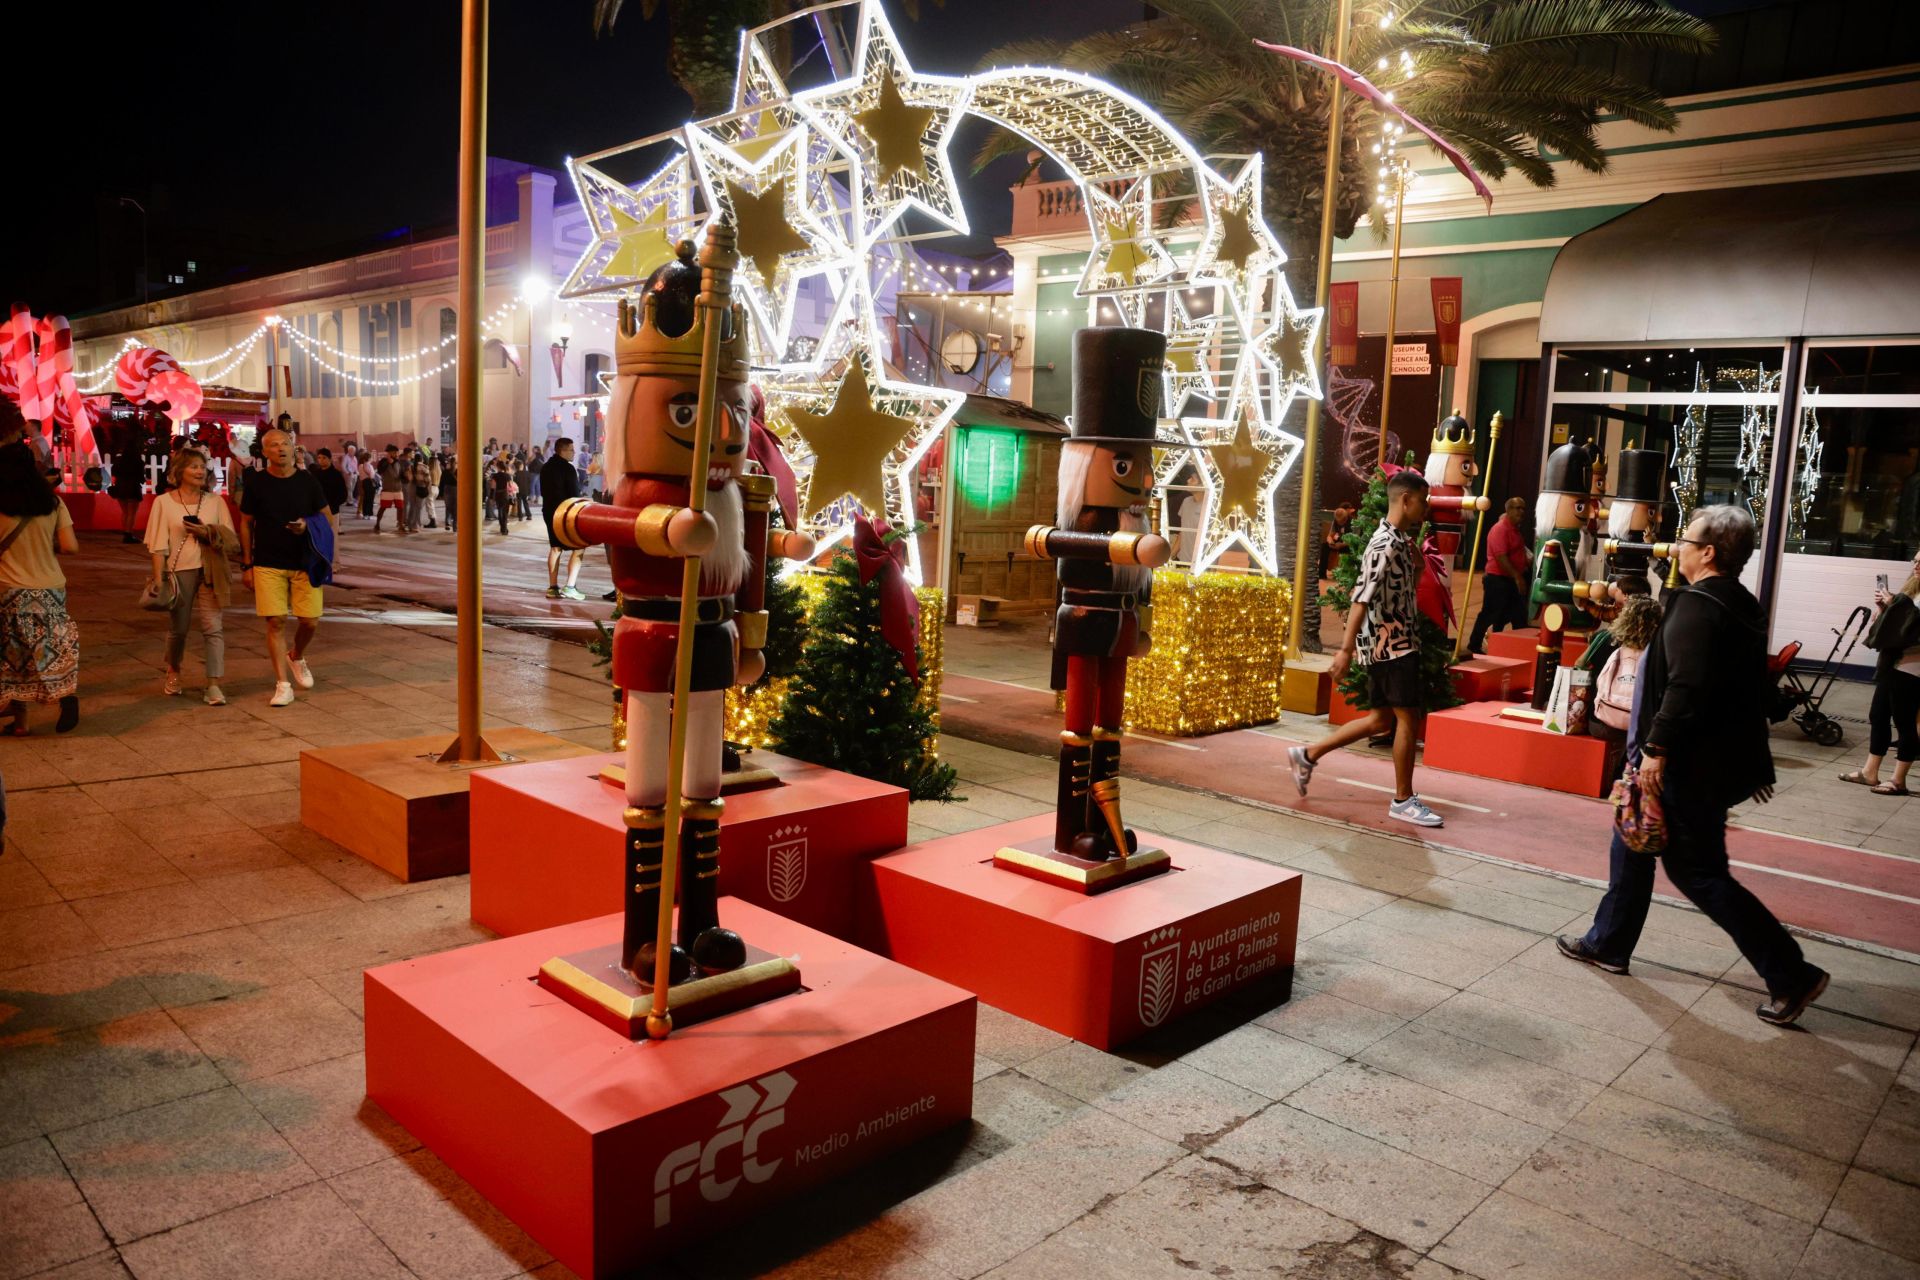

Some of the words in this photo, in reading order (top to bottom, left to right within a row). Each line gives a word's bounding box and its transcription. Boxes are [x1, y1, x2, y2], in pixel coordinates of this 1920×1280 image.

[1186, 963, 1202, 982] de
[1210, 952, 1231, 972] Las
[1237, 932, 1279, 960] Palmas
[1187, 911, 1281, 960] Ayuntamiento
[1184, 985, 1200, 1005] de
[1202, 973, 1231, 996] Gran
[1235, 953, 1277, 981] Canaria
[795, 1132, 849, 1168] Medio
[855, 1094, 936, 1141] Ambiente
[654, 1106, 785, 1230] FCC
